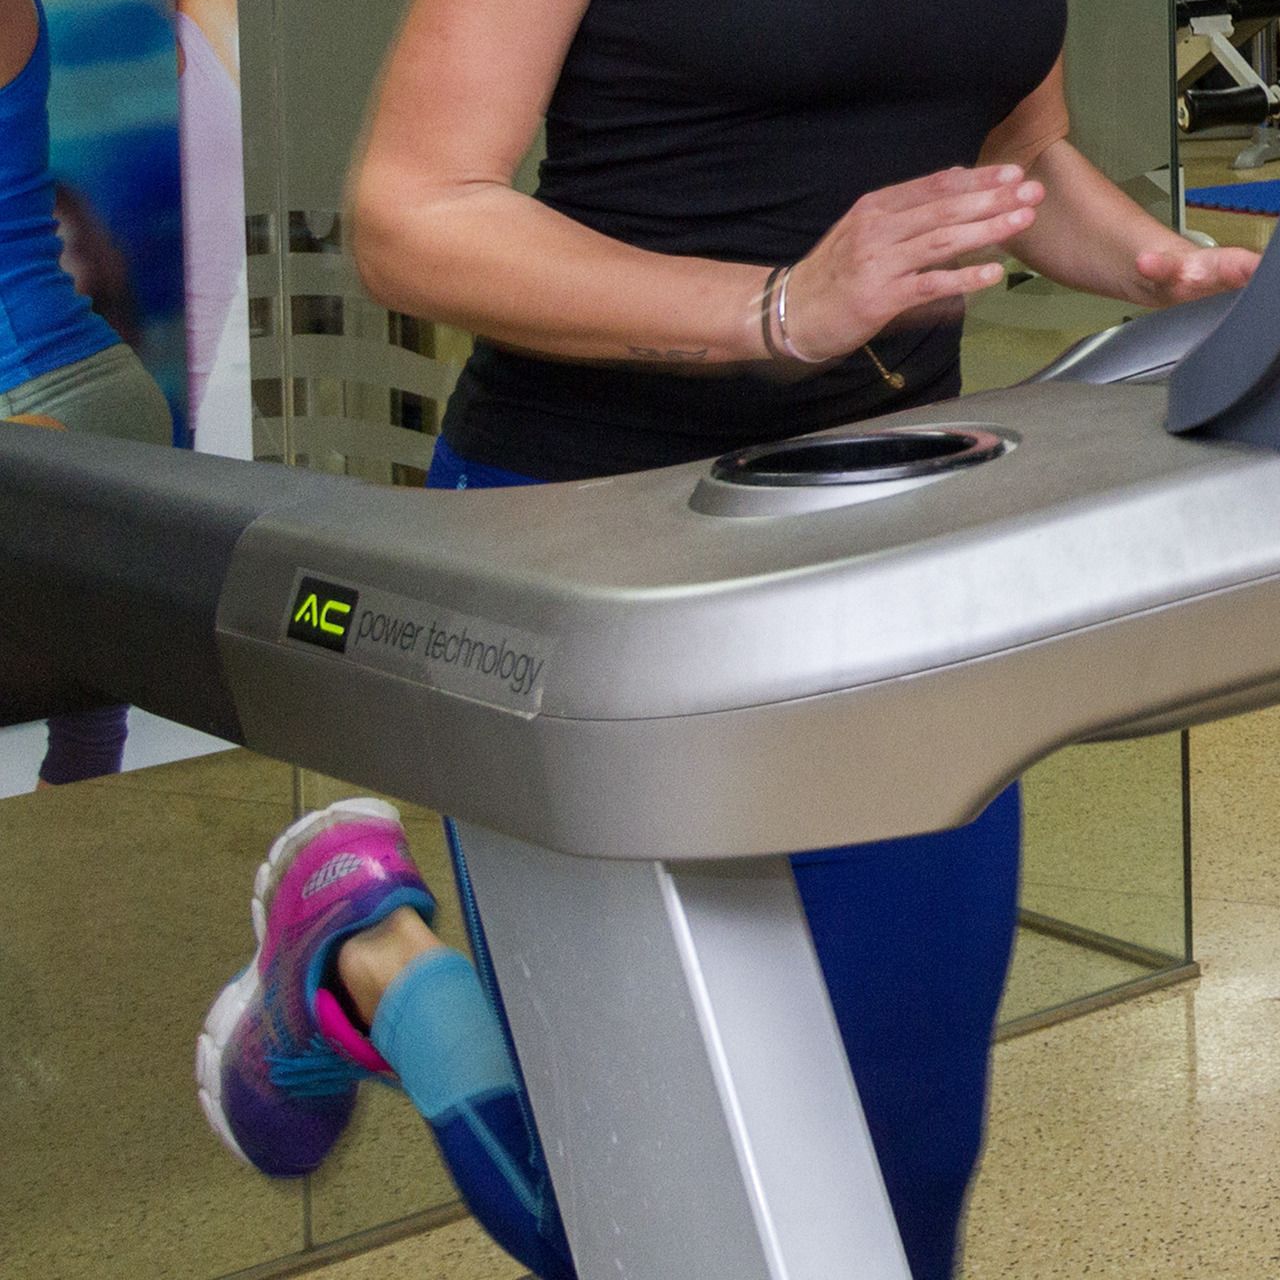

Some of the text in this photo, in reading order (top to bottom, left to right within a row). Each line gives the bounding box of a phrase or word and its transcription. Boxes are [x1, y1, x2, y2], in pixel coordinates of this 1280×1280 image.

[294, 593, 545, 695] AC power technology
